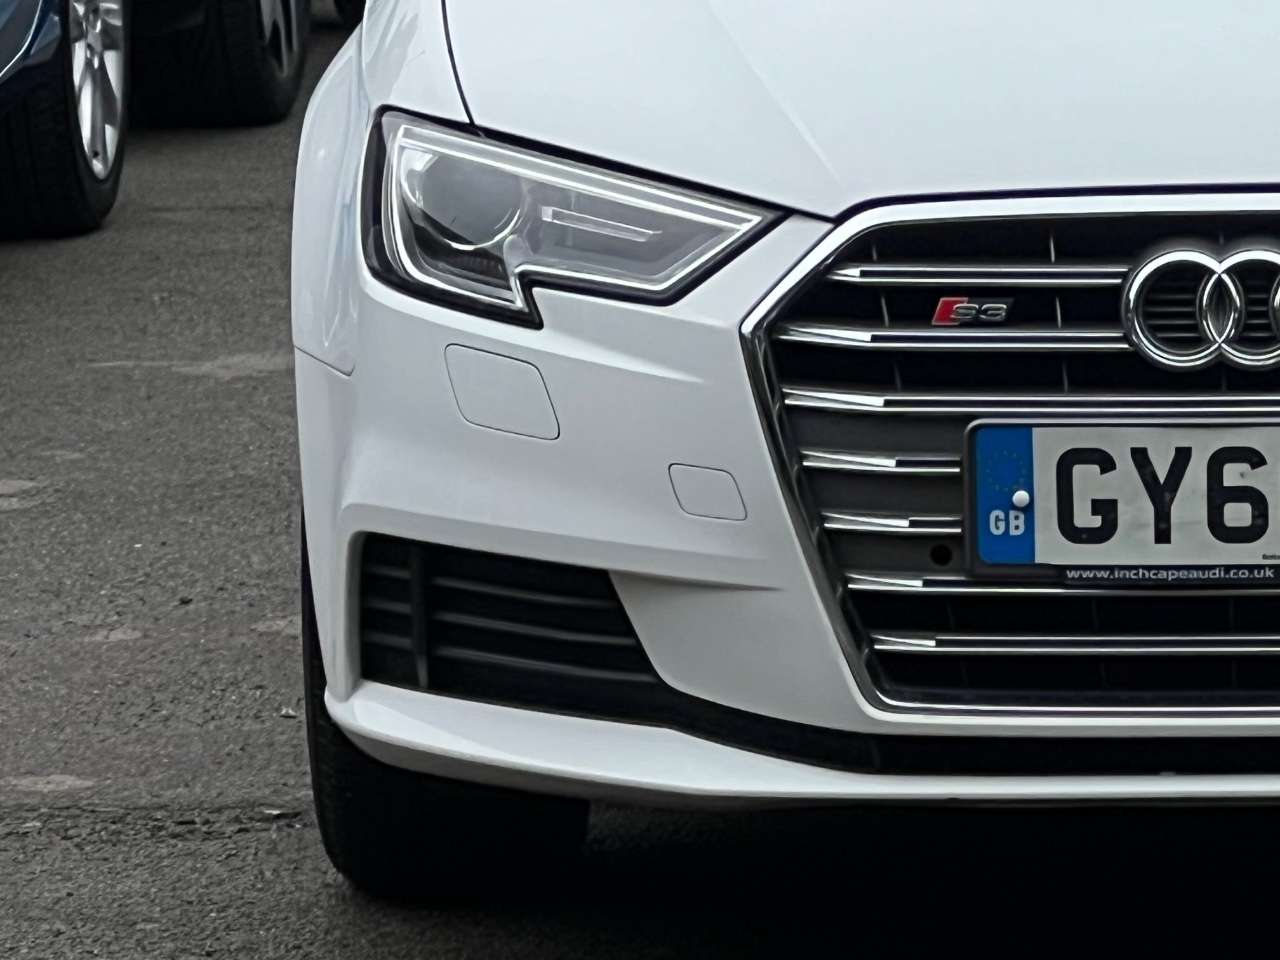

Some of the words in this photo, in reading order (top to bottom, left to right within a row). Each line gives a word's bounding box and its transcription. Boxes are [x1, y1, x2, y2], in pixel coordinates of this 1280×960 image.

[950, 303, 1008, 320] S3
[989, 509, 1026, 536] GB
[1066, 567, 1275, 581] www.inchcapeaudi.co.uk
